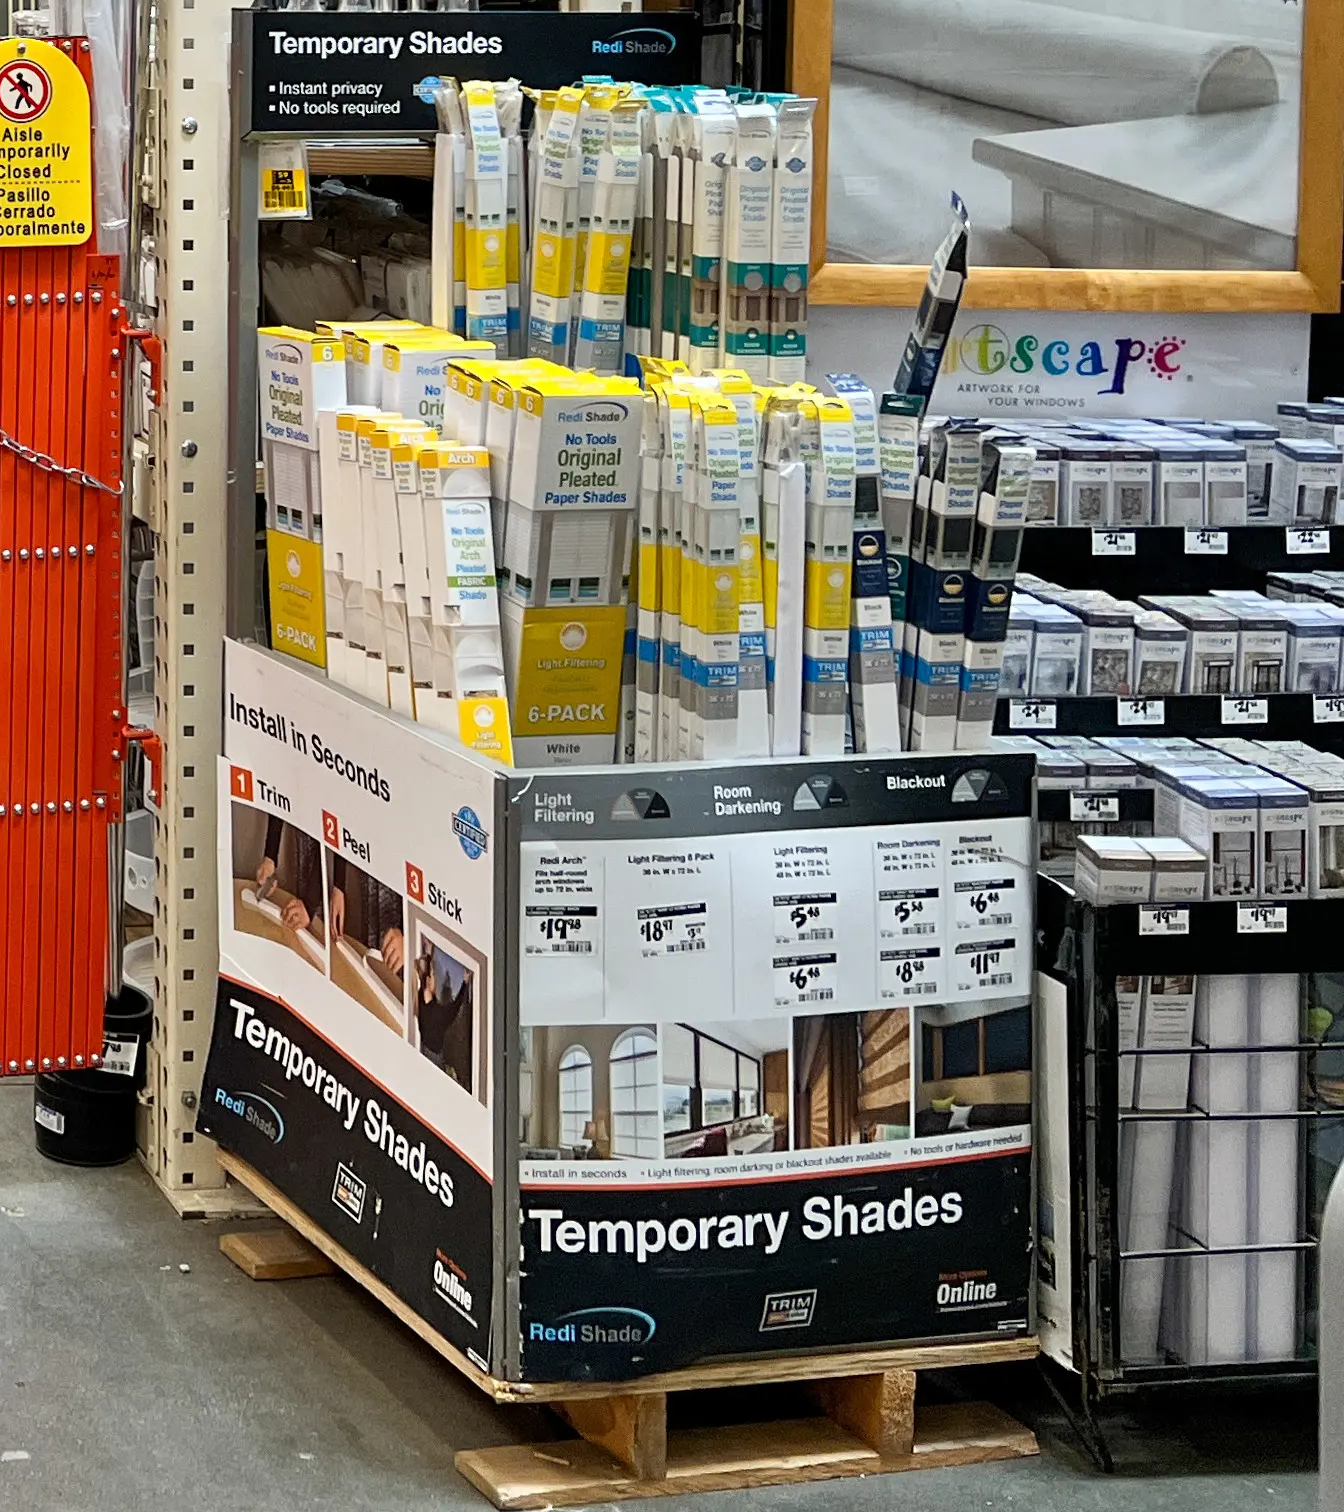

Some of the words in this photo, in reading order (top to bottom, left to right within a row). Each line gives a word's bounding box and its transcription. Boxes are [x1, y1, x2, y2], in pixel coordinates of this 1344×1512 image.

[269, 31, 403, 60] Temporary
[409, 29, 502, 55] Shades
[592, 39, 623, 54] Redi
[624, 38, 668, 55] Shade
[279, 81, 328, 97] Instant
[331, 81, 383, 99] privacy
[279, 101, 299, 115] No
[302, 100, 329, 115] tools
[332, 99, 401, 119] required
[2, 127, 43, 142] Aisle
[322, 346, 334, 362] 6
[269, 385, 304, 407] Original
[957, 383, 1014, 394] ARTWORK
[1017, 383, 1041, 394] FOR
[987, 396, 1020, 408] YOUR
[1023, 397, 1086, 408] WINDOWS
[271, 404, 303, 427] Pleated
[557, 410, 583, 423] Redi
[584, 409, 621, 423] Shade
[565, 434, 582, 445] No
[584, 433, 618, 446] Tools
[447, 451, 476, 465] Arch
[557, 447, 622, 472] Original
[558, 468, 617, 488] Pleated
[544, 491, 580, 507] Paper
[582, 490, 627, 505] Shades
[451, 537, 487, 551] Original
[457, 576, 487, 587] FABRIC
[275, 626, 317, 653] 6-PACK
[816, 659, 847, 673] TRIM
[527, 704, 606, 723] 6-PACK
[229, 692, 287, 744] Install
[290, 722, 308, 755] in
[310, 733, 391, 803] Seconds
[546, 742, 581, 754] White
[886, 773, 947, 791] Blackout
[237, 773, 246, 794] 1
[256, 779, 292, 813] Trim
[713, 784, 752, 800] Room
[534, 793, 573, 810] Light
[714, 798, 783, 817] Darkening
[534, 807, 595, 825] Filtering
[325, 817, 336, 840] 2
[342, 827, 372, 864] Peel
[410, 870, 420, 893] 3
[427, 881, 463, 925] Stick
[229, 998, 361, 1131] Temporary
[363, 1098, 455, 1208] Shades
[214, 1088, 246, 1117] Redi
[245, 1103, 277, 1142] Shade
[531, 1168, 565, 1179] Install
[568, 1168, 579, 1179] in
[581, 1168, 628, 1180] seconds
[529, 1207, 791, 1263] Temporary
[802, 1188, 964, 1242] Shades
[433, 1259, 473, 1313] Online
[936, 1280, 997, 1305] Online
[770, 1295, 812, 1311] TRIM
[530, 1321, 576, 1343] Redi
[581, 1323, 643, 1344] Shade
